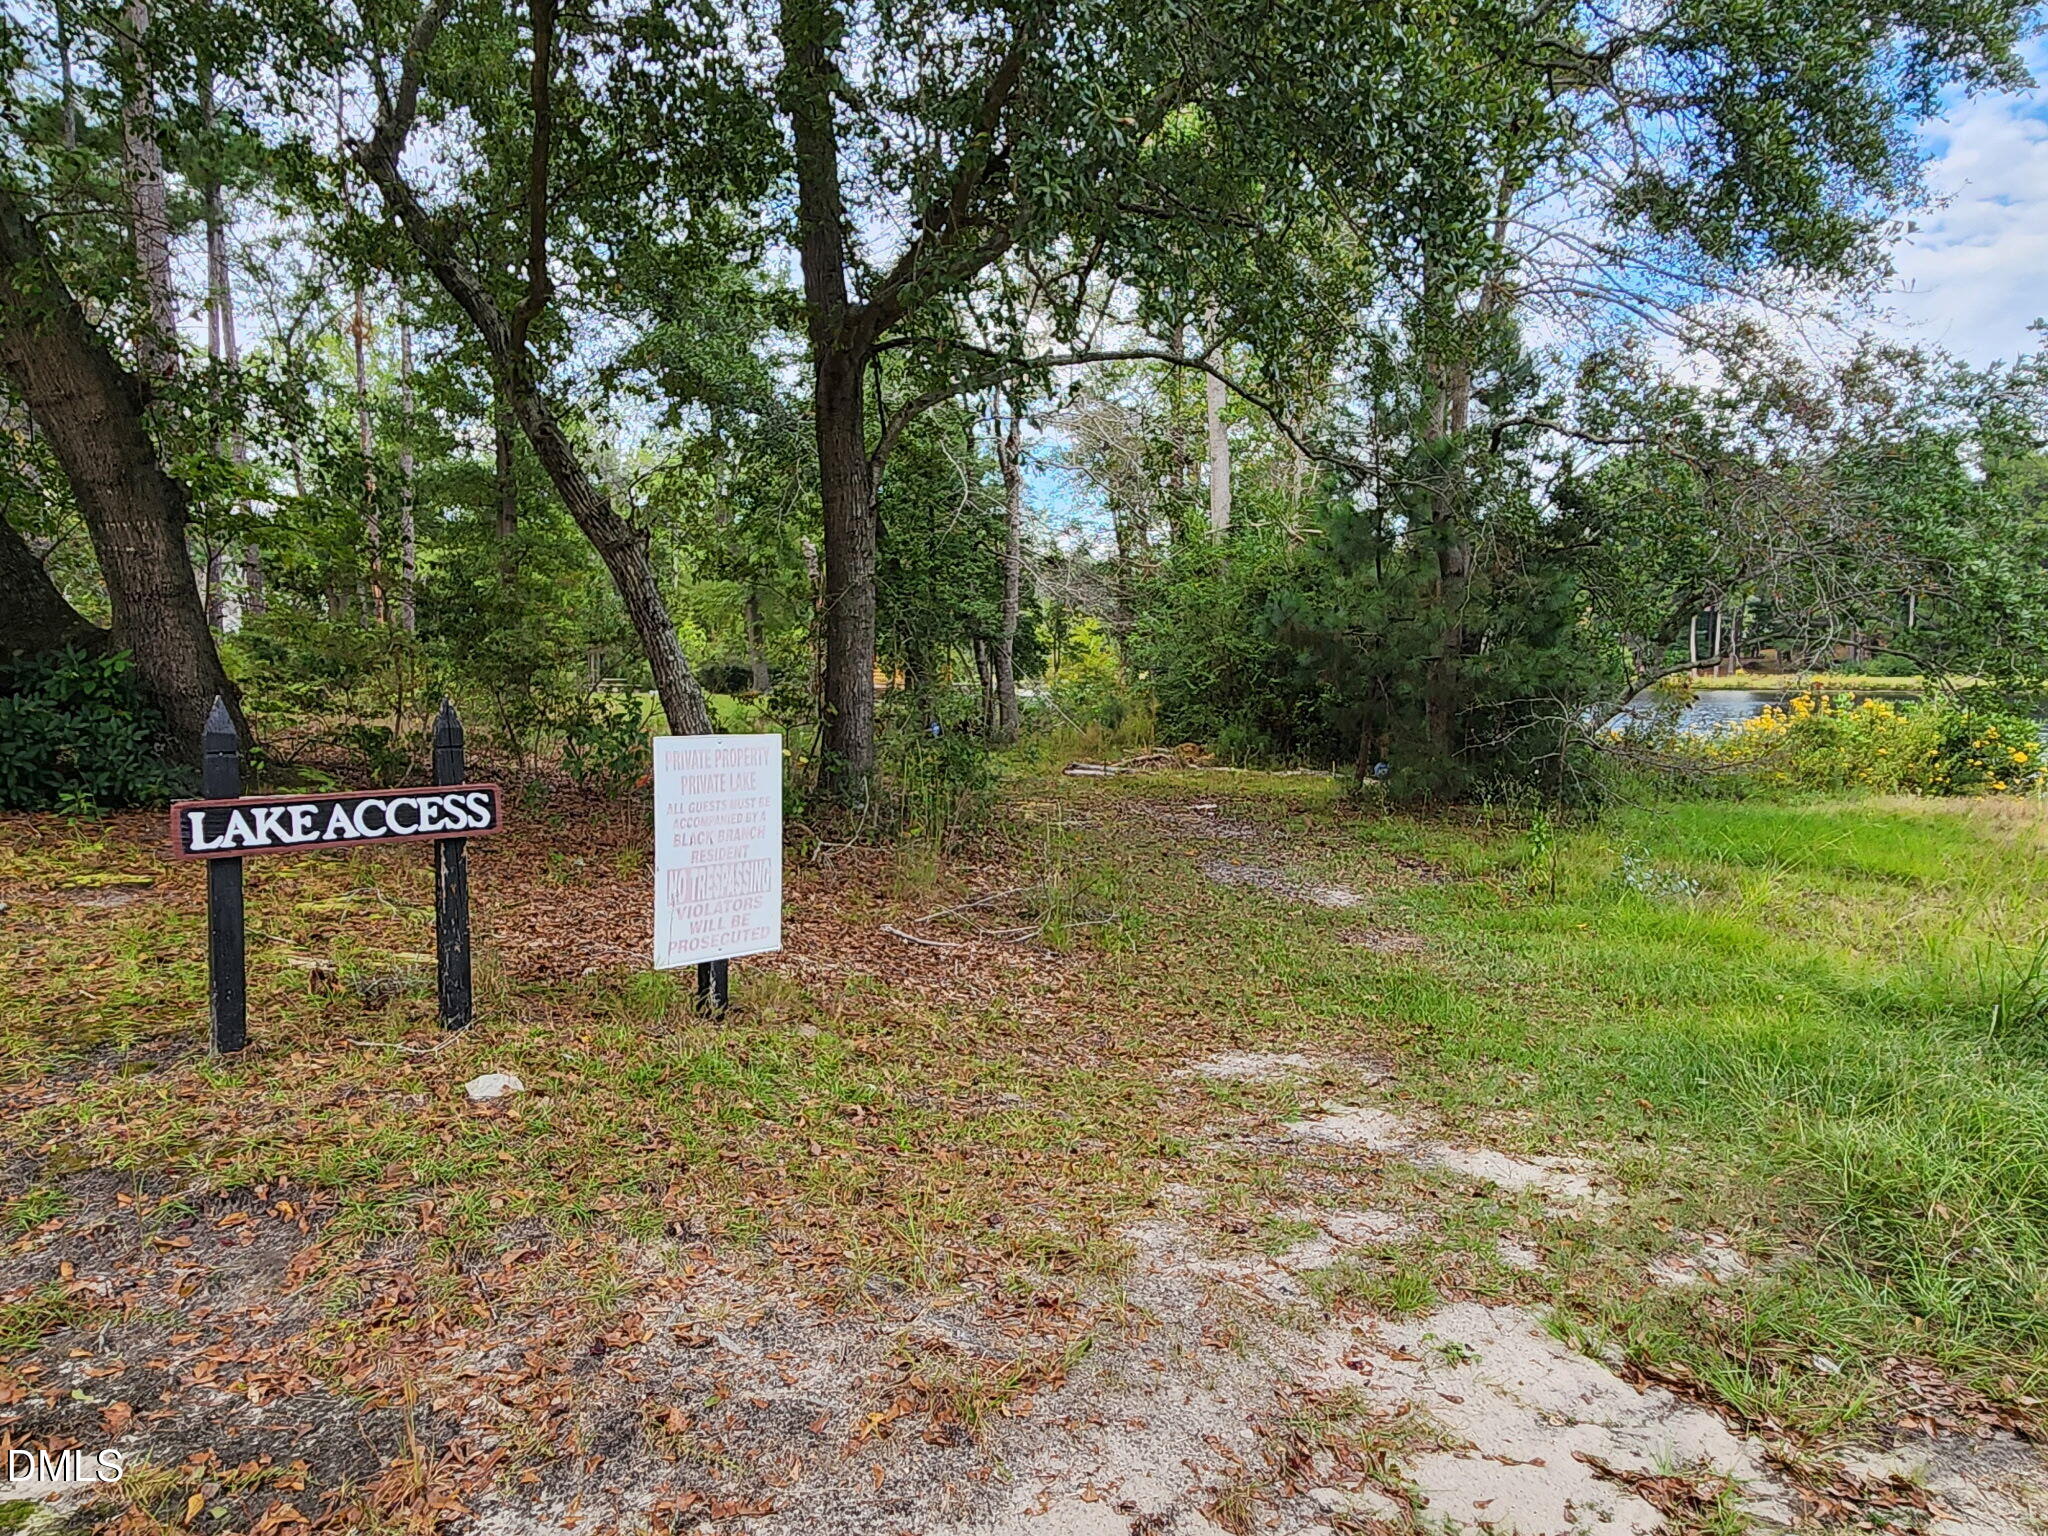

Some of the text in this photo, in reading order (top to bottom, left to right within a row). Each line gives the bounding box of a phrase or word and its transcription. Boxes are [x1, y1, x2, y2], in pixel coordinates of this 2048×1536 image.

[665, 746, 770, 771] PRIVATE PROPERTY
[681, 772, 756, 795] PRIVATE LAKE
[666, 802, 684, 816] ALL
[689, 800, 727, 813] GUESTS
[729, 797, 756, 810] MUST
[187, 792, 491, 851] LAKE ACCESS
[673, 813, 743, 830] ACCOMPANIED
[673, 825, 766, 848] BLACK BRANCH
[691, 845, 748, 864] RESIDENT
[667, 859, 770, 906] NO TRESPASSING
[676, 896, 763, 920] VIOLATORS
[690, 913, 750, 935] WILL BE
[669, 926, 771, 954] PROSECUTED
